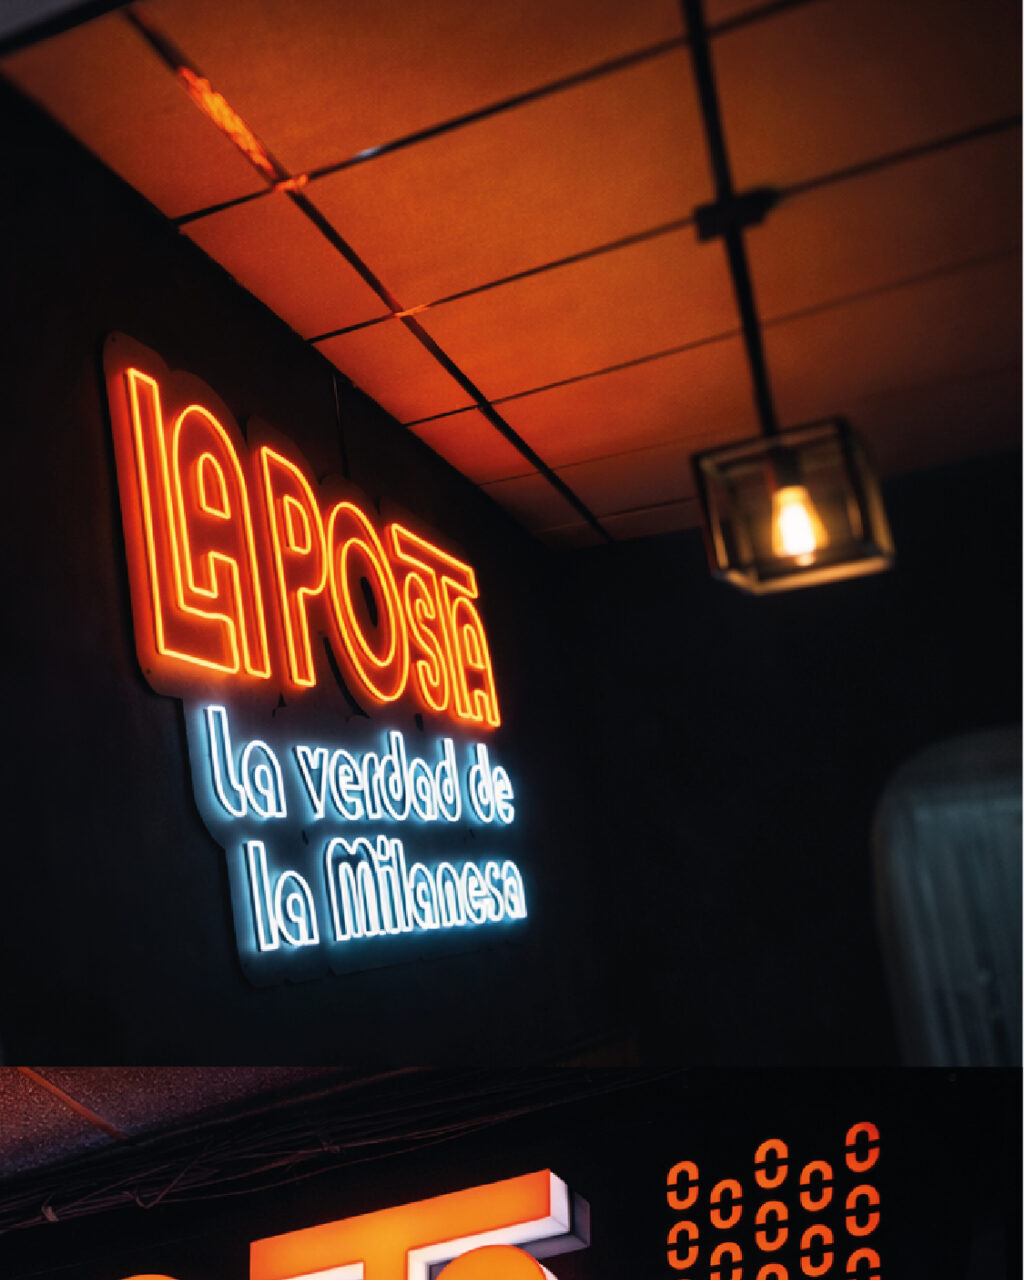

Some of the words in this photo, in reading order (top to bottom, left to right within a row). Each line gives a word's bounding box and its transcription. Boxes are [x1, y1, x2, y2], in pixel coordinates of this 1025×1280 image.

[127, 367, 272, 679] LA
[261, 446, 501, 727] POSTA
[207, 705, 288, 818] La
[296, 731, 462, 822] verdad
[469, 742, 515, 824] de
[246, 841, 320, 951] la
[326, 835, 528, 941] Milanesa
